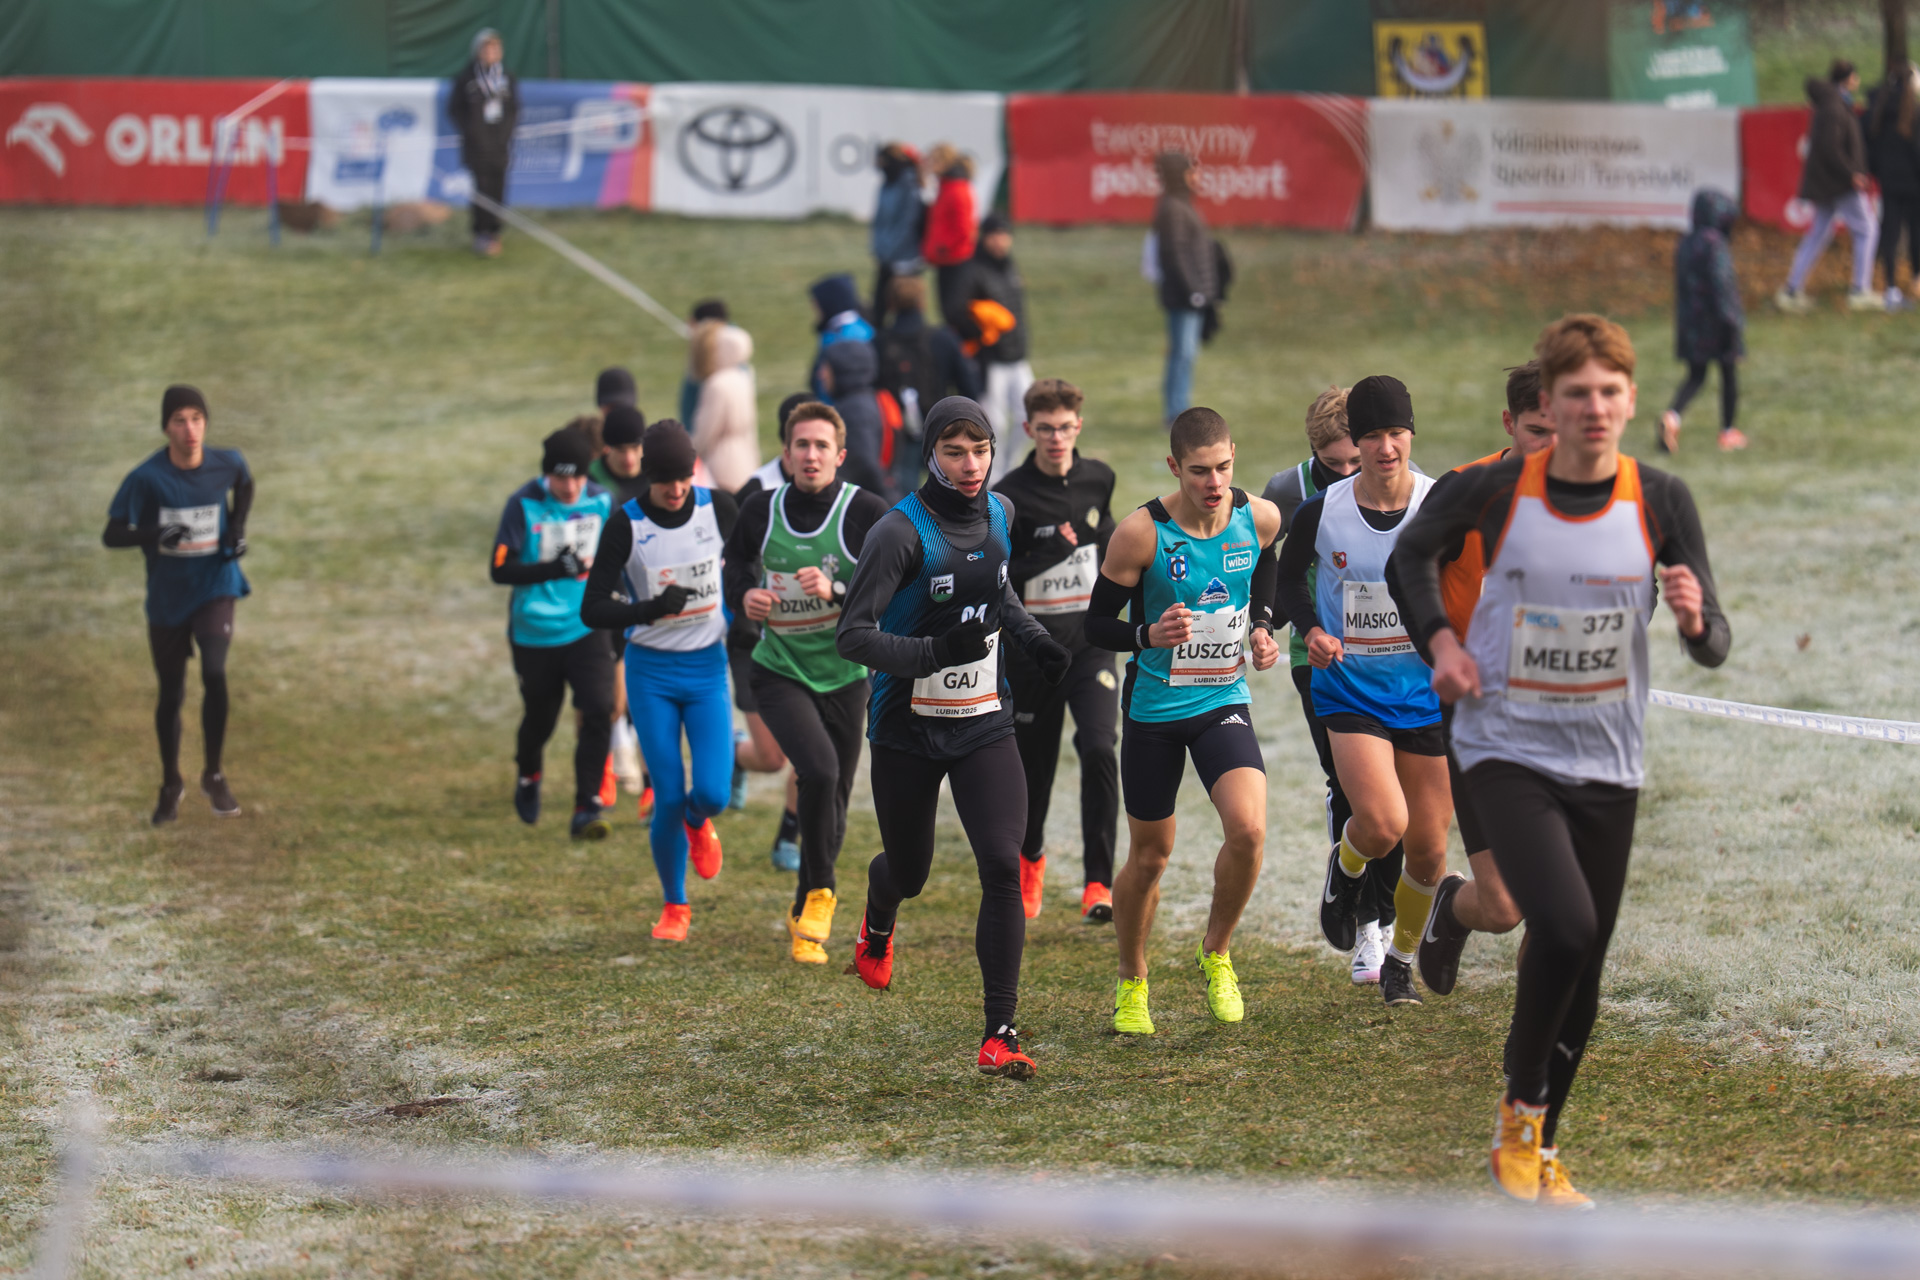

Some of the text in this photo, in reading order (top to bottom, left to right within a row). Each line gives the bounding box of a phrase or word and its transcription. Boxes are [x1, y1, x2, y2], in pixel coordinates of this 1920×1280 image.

[105, 113, 285, 166] ORLEN
[691, 559, 713, 577] 127
[1228, 556, 1249, 568] wibo
[1042, 575, 1082, 592] PYŁA
[1345, 611, 1404, 629] MIASKO
[1582, 611, 1624, 635] 373
[1177, 639, 1242, 660] ŁUSZCZ
[1367, 643, 1411, 654] LUBIN 2025
[1523, 646, 1618, 672] MELESZ
[943, 671, 979, 690] GAJ
[1218, 675, 1236, 683] 2025
[961, 706, 977, 715] 2025
